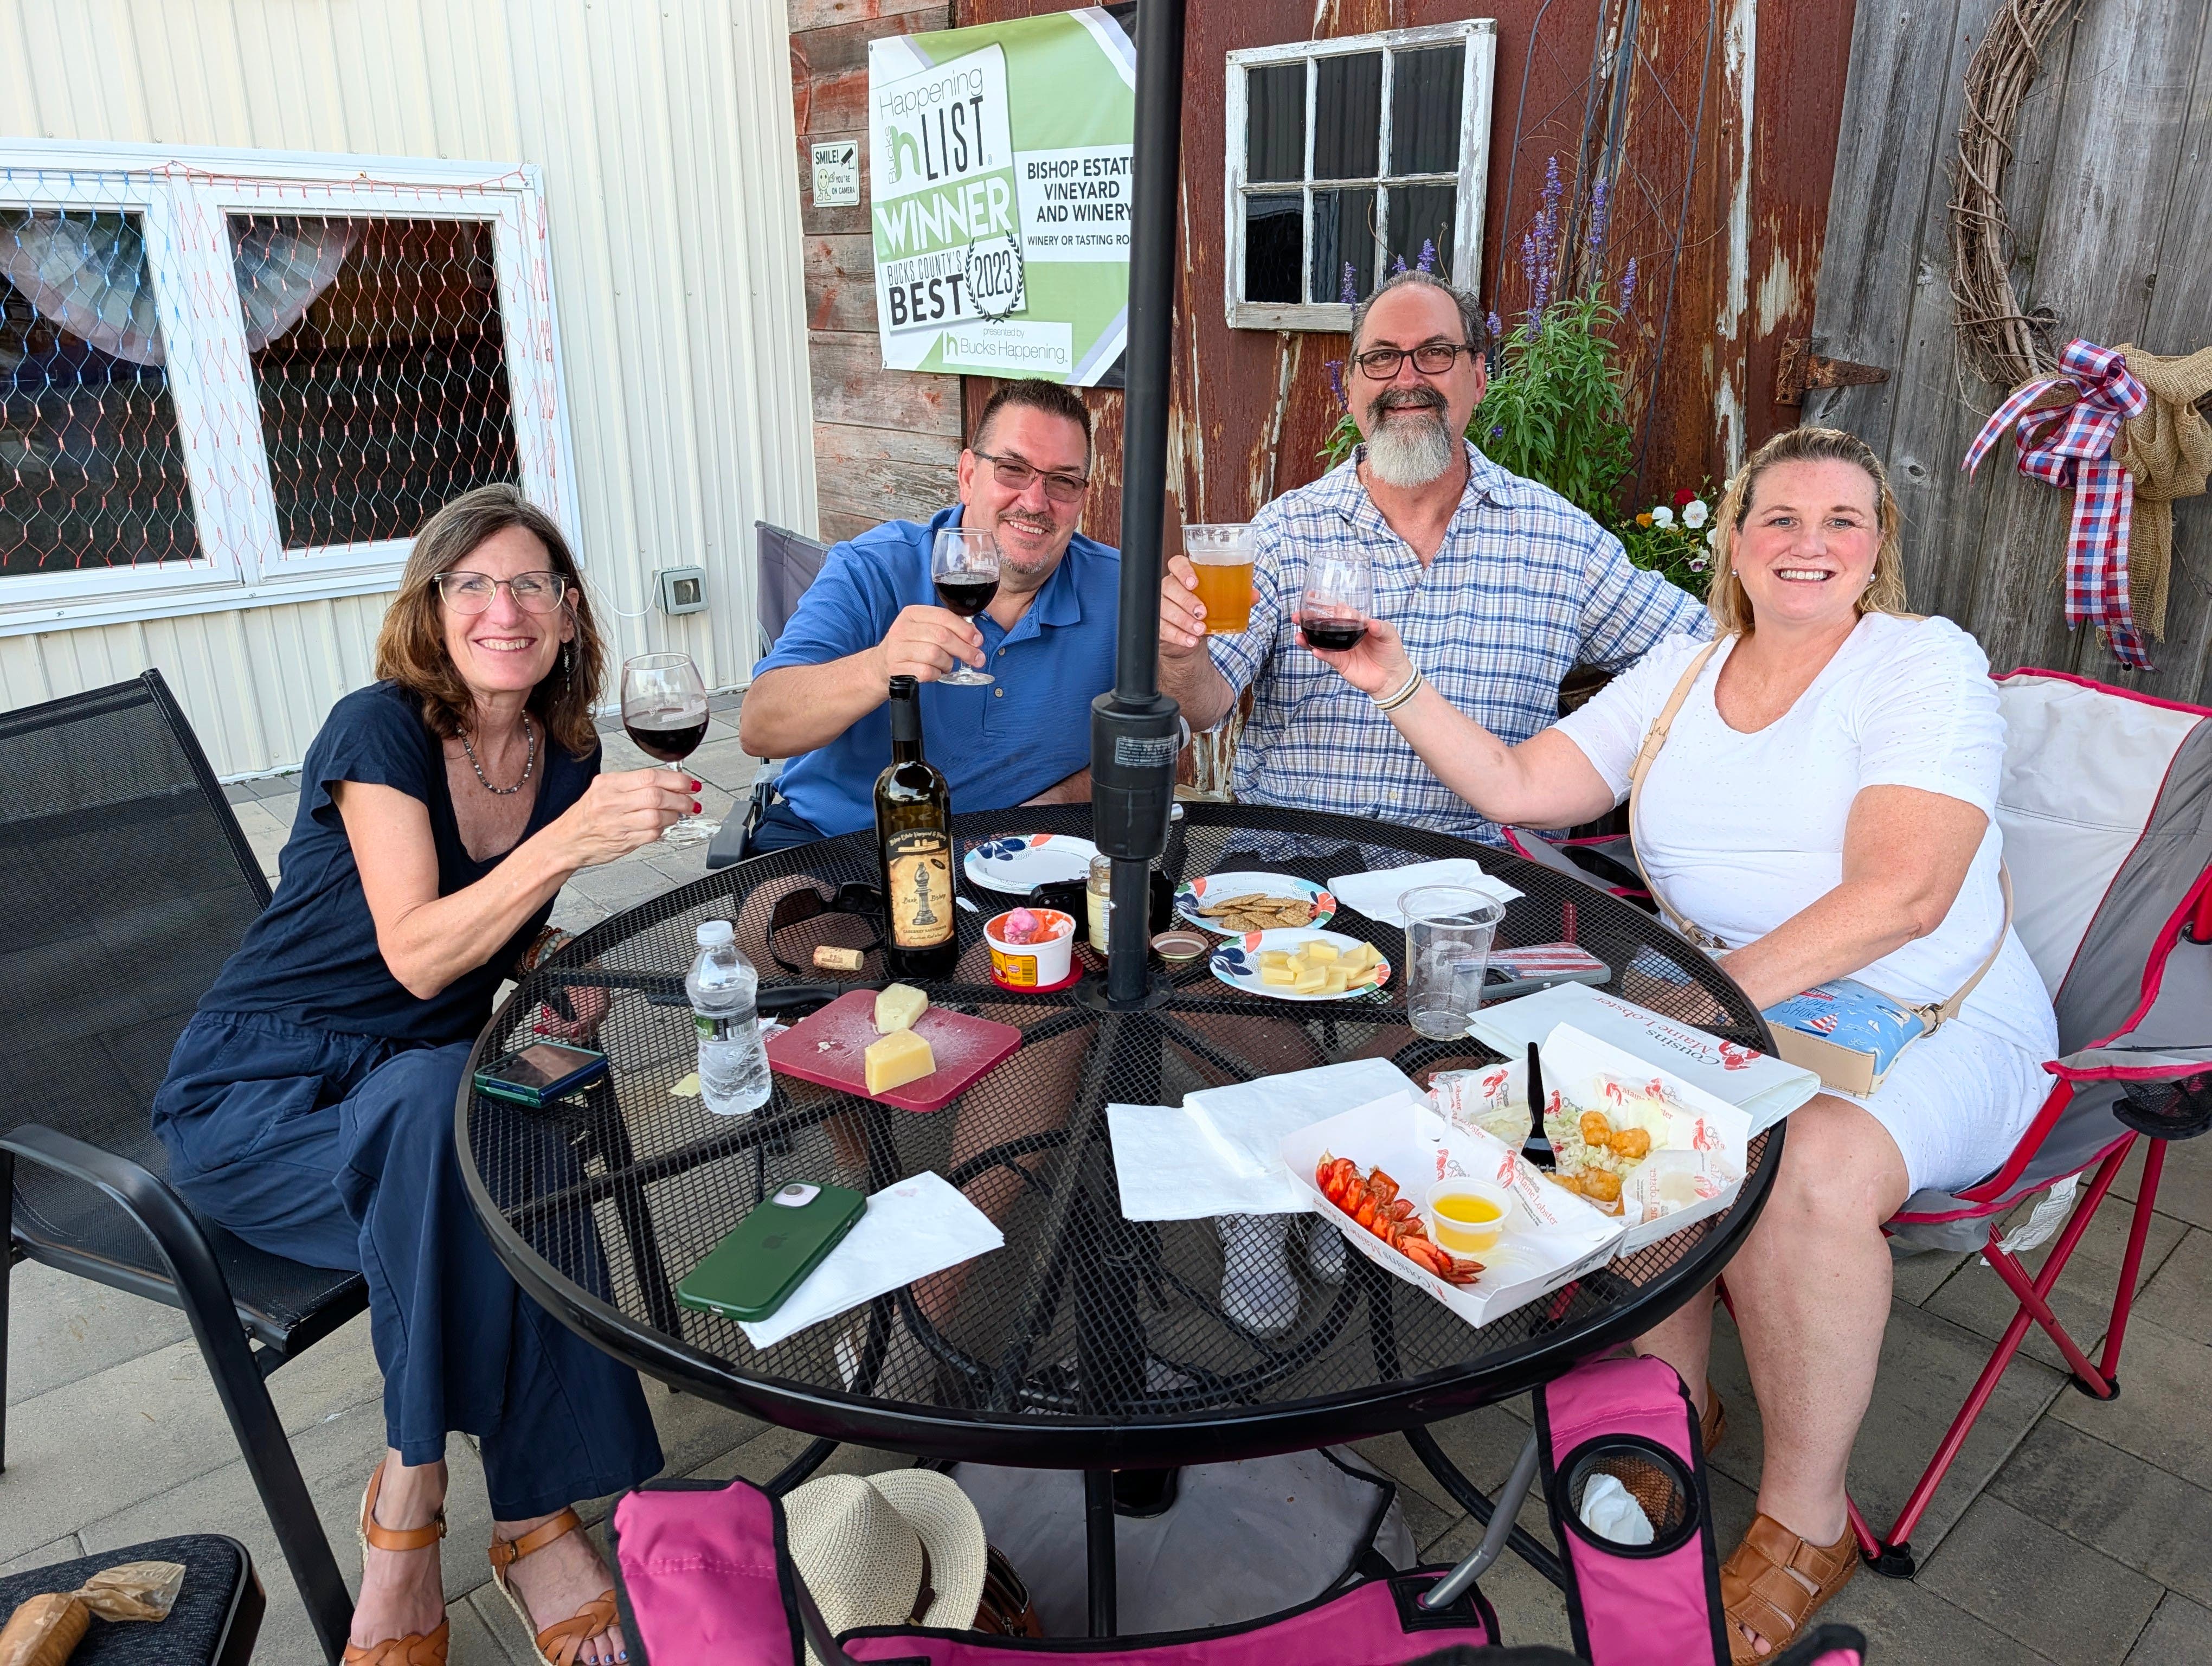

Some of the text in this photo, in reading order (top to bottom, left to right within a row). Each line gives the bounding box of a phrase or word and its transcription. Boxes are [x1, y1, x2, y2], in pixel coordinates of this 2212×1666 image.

[879, 67, 983, 120] Happening
[921, 95, 983, 181] LIST
[815, 149, 839, 164] SMILE!
[885, 125, 897, 184] Bucks
[835, 175, 850, 184] YOU'RE
[1028, 160, 1078, 180] BISHOP
[839, 187, 855, 195] CAMERA
[1044, 181, 1120, 200] VINEYARD
[874, 176, 1013, 255] WINNER
[1037, 203, 1131, 222] AND WINERY
[1027, 234, 1130, 246] WINERY OR TASTING RO
[888, 250, 962, 286] BUCKS COUNTY'S
[975, 249, 1013, 298] 2023
[889, 273, 963, 326] BEST
[983, 328, 1025, 338] presented by
[961, 338, 1064, 364] Bucks Happening
[1592, 997, 1656, 1027] Lobster
[1782, 1003, 1819, 1019] SHORE
[1796, 997, 1841, 1009] DOWN
[1645, 1029, 1720, 1065] Cousins
[1658, 1026, 1715, 1054] Maine
[1516, 1175, 1535, 1199] Maine
[1533, 1192, 1558, 1225] Lobster
